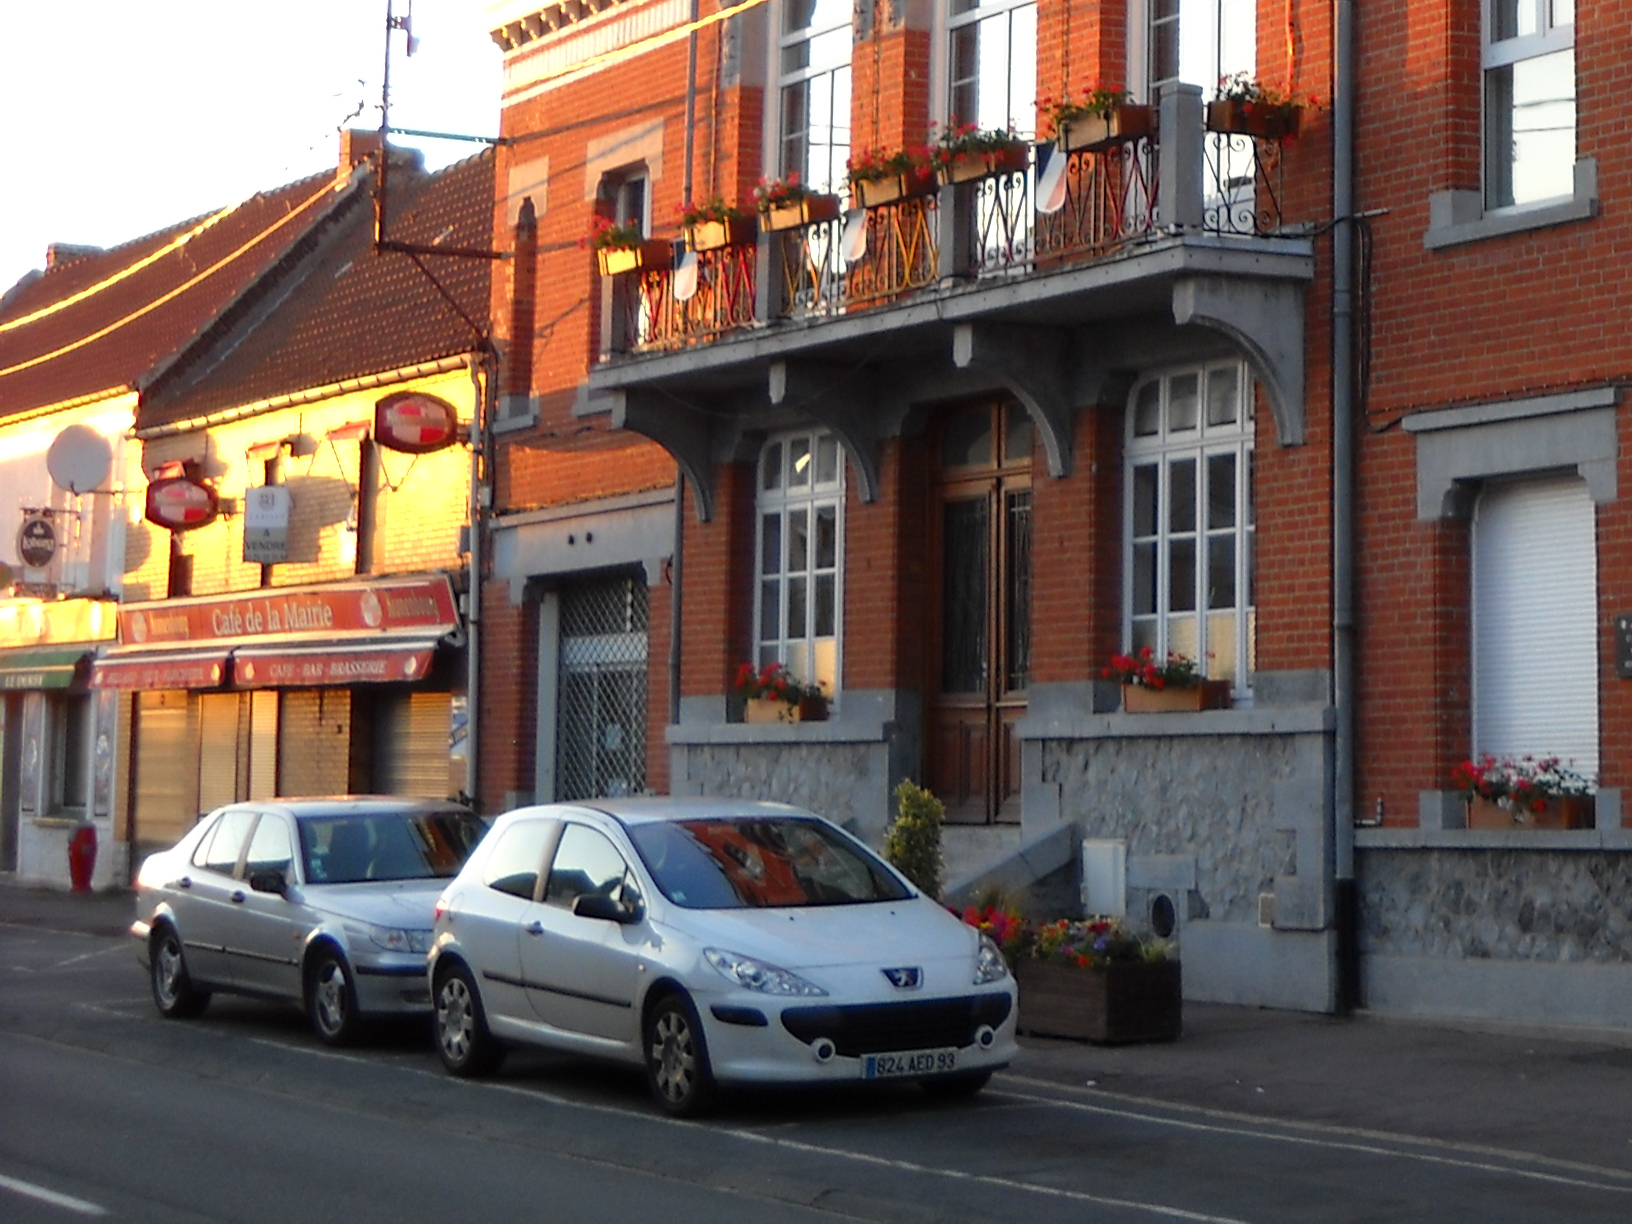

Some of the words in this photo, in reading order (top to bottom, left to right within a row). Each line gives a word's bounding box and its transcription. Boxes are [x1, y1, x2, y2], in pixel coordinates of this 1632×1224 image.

[212, 604, 243, 637] Café
[246, 601, 263, 633] de
[266, 599, 281, 632] la
[284, 598, 333, 630] Mairie
[330, 660, 388, 675] BRASSERIE
[877, 1057, 904, 1074] 824
[908, 1054, 935, 1072] AED
[937, 1052, 955, 1069] 93
